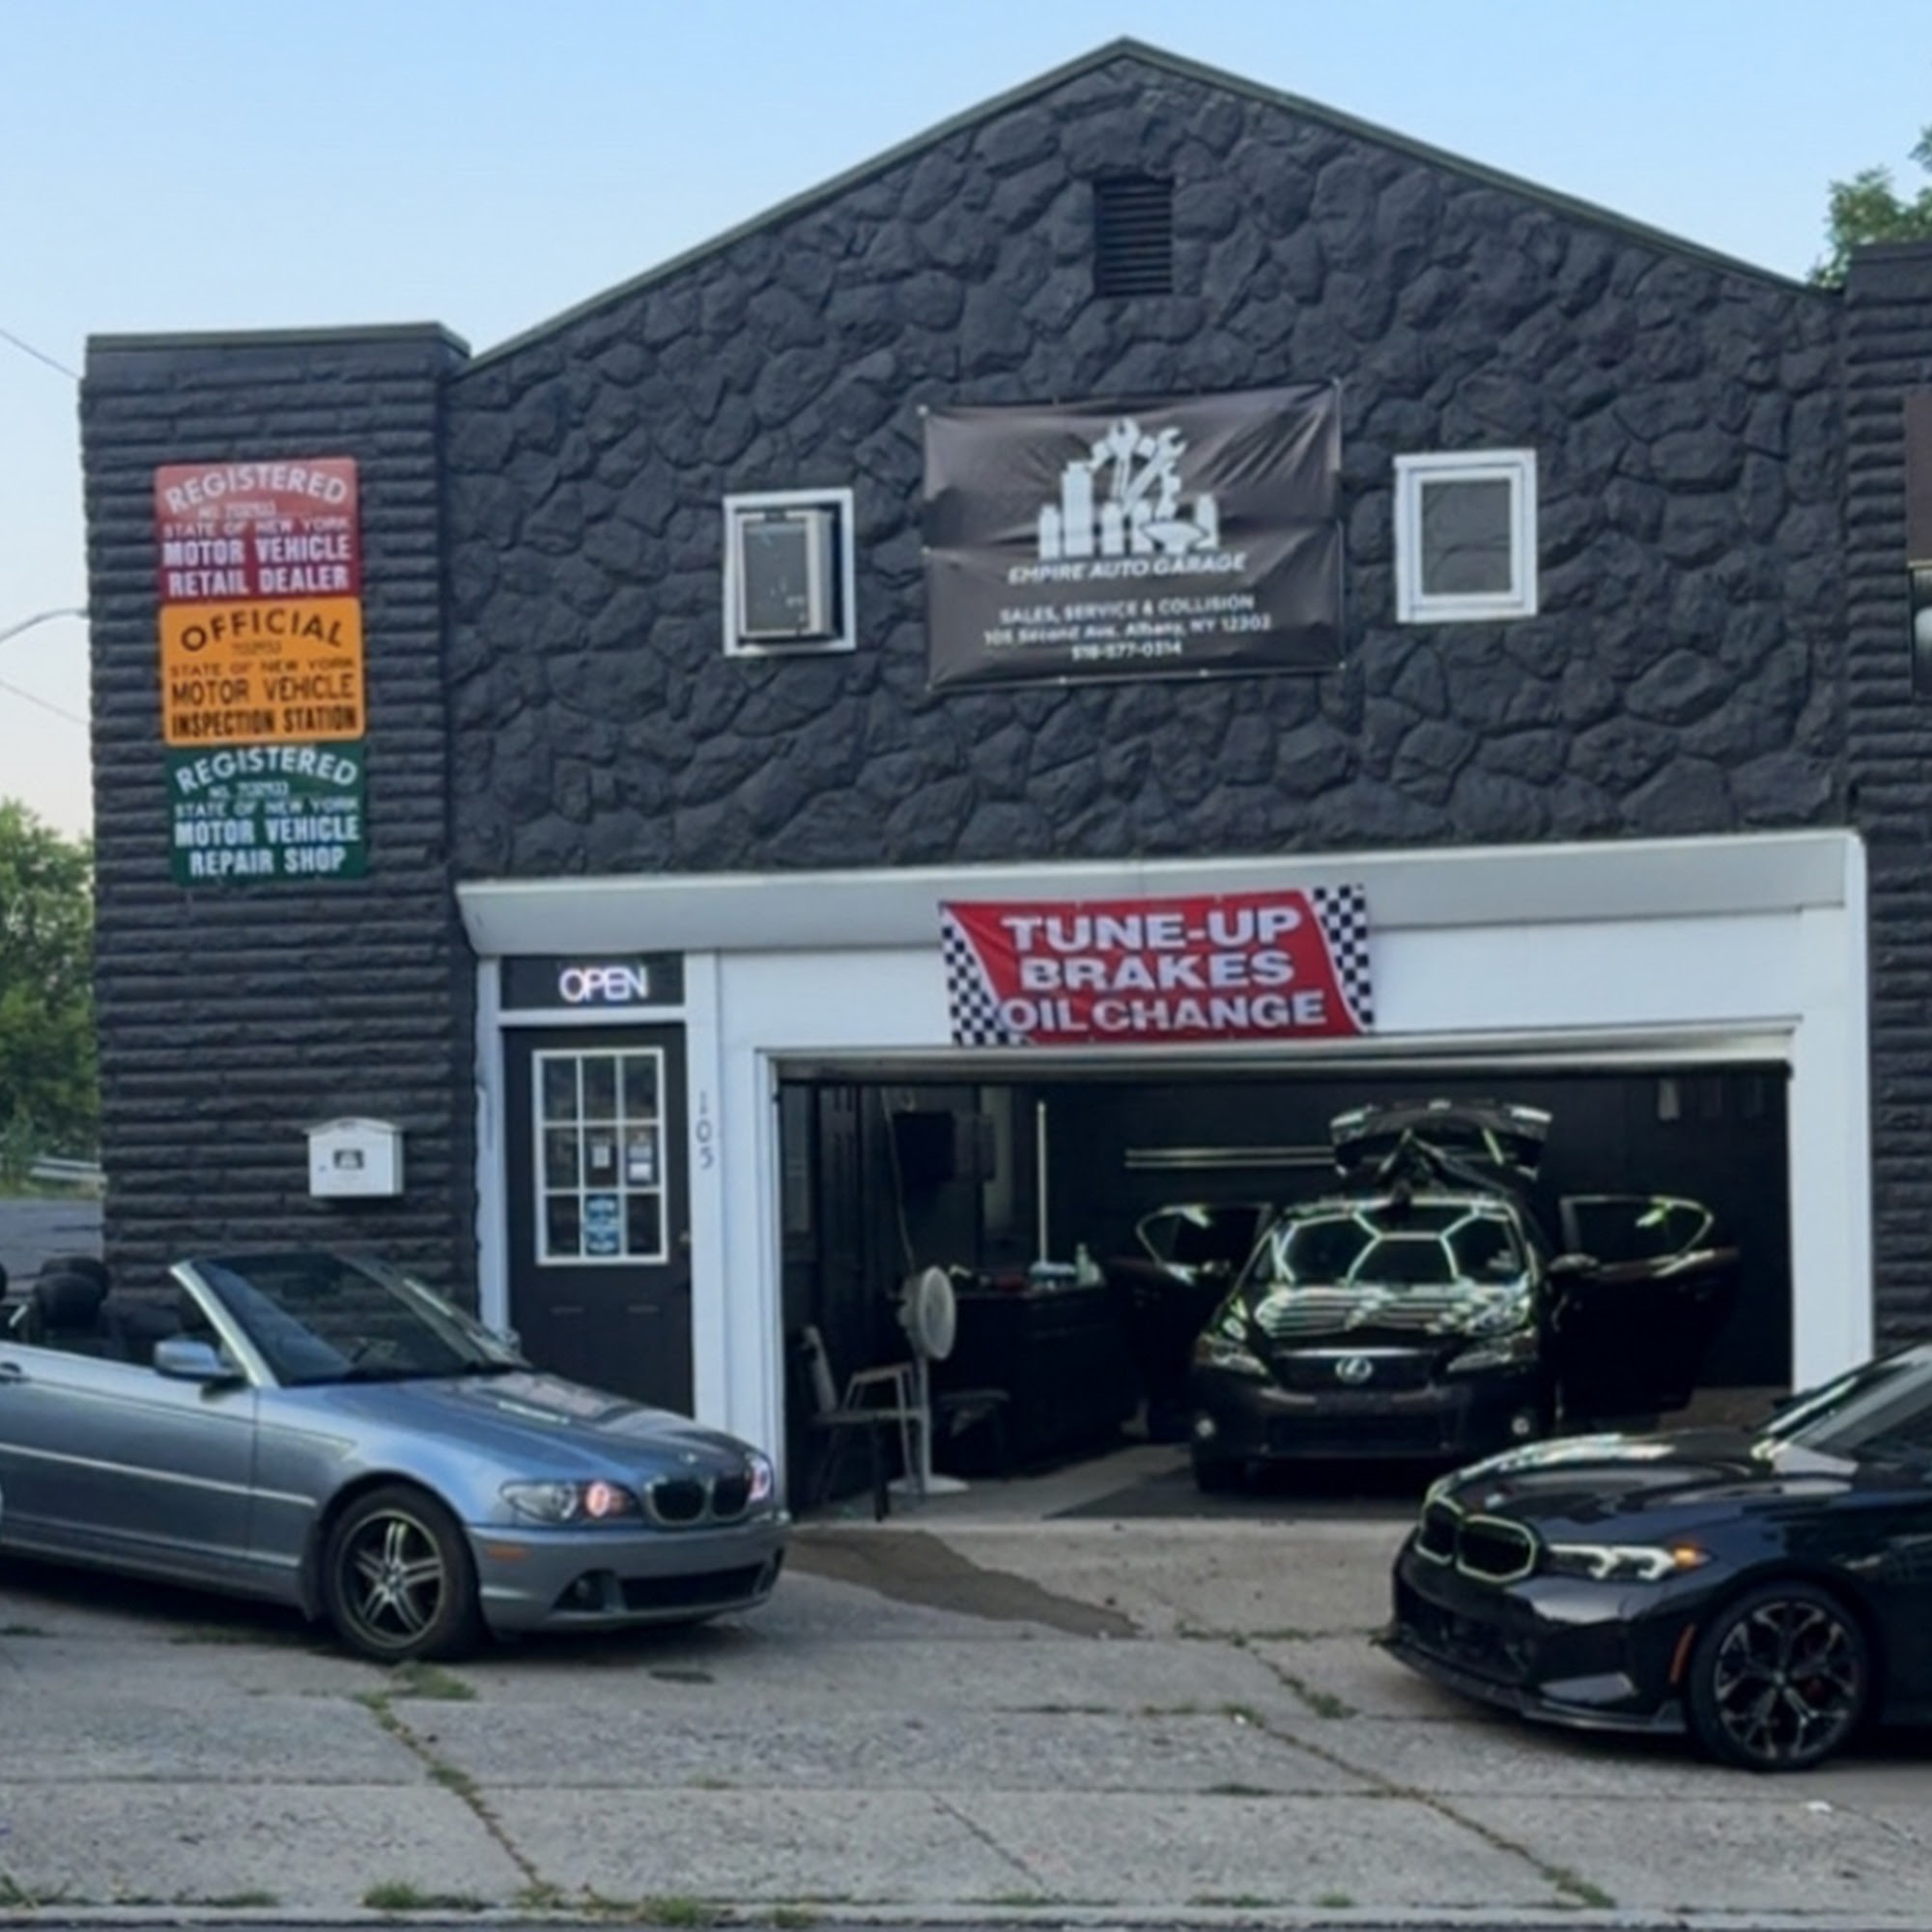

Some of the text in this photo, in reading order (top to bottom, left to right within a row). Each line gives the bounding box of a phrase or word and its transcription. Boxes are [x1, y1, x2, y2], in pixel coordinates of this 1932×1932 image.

[164, 464, 347, 514] REGISTERED
[163, 522, 215, 537] STATE
[255, 517, 293, 533] NEW
[303, 515, 350, 531] YORK
[162, 534, 352, 566] MOTOR VEHICLE
[168, 564, 349, 597] RETAIL DEALER
[1009, 552, 1247, 584] EMPIRE AUTO GARAGE
[1064, 600, 1137, 622] SERVICE
[1158, 593, 1255, 615] COLLISION
[181, 608, 342, 651] OFFICIAL
[1190, 619, 1215, 634] NY
[170, 662, 222, 678] STATE
[260, 658, 298, 673] NEW
[308, 657, 354, 671] YORK
[172, 674, 355, 705] MOTOR VEHICLE
[172, 706, 356, 737] INSPECTION STATION
[175, 746, 357, 794] REGISTERED
[175, 802, 226, 819] STATE
[265, 799, 303, 815] NEW
[312, 797, 359, 812] YORK
[174, 815, 360, 847] MOTOR VEHICLE
[190, 845, 346, 876] REPAIR SHOP
[1001, 906, 1301, 952] TUNE-UP
[559, 965, 648, 1002] OPEN
[1021, 951, 1294, 991] BRAKES
[1000, 990, 1327, 1032] OIL CHANGE
